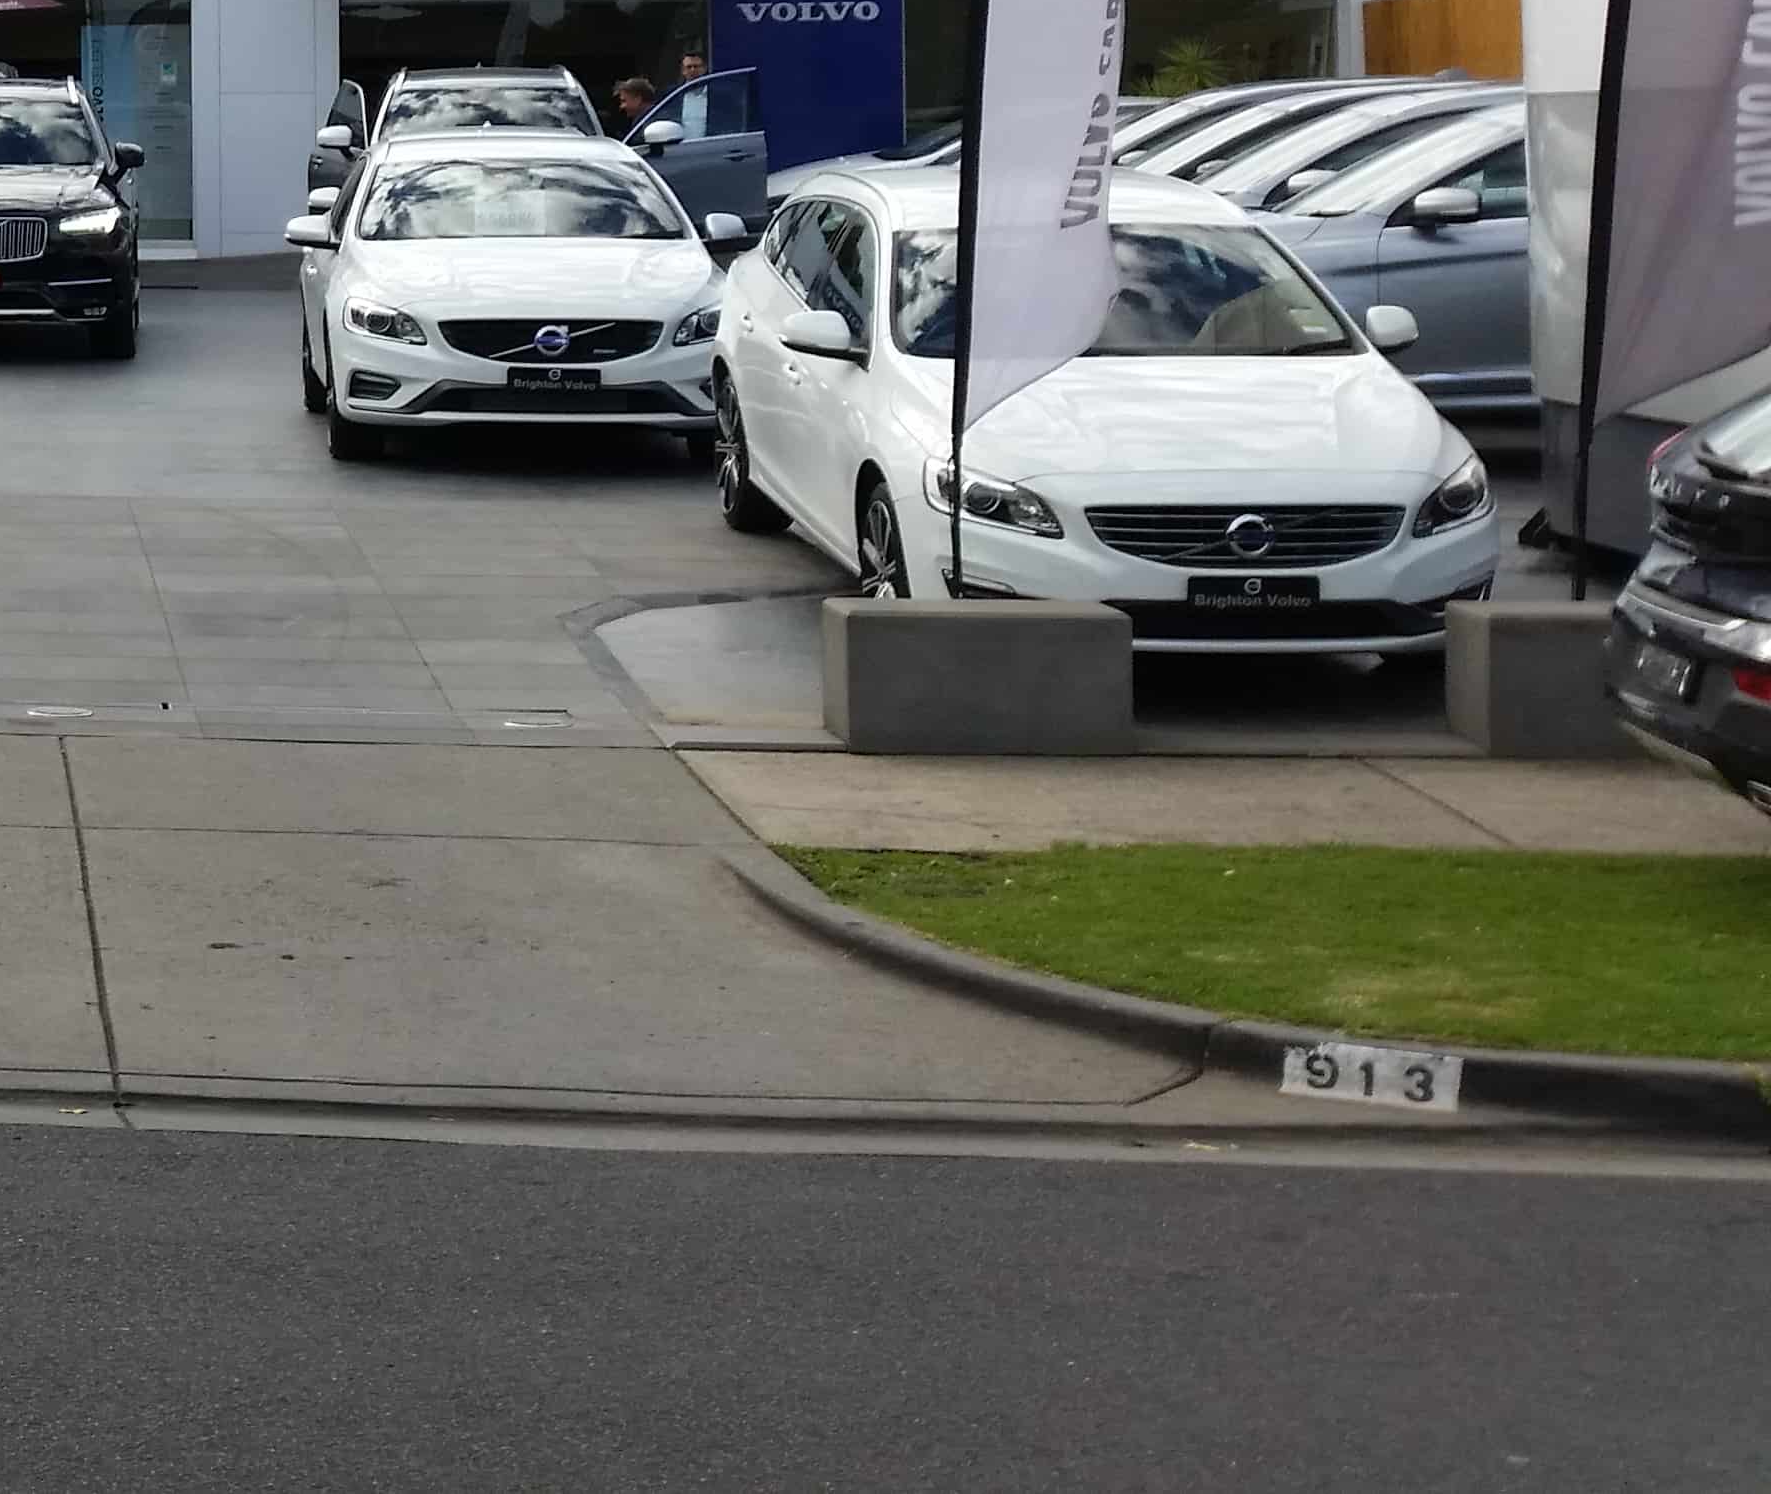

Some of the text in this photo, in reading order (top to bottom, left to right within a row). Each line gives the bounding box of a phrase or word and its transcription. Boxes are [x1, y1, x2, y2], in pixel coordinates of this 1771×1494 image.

[737, 1, 881, 24] VOLVO
[513, 379, 597, 392] Brighton Volvo
[1194, 593, 1311, 610] Brighton Volvo
[1306, 1053, 1435, 1102] 913
